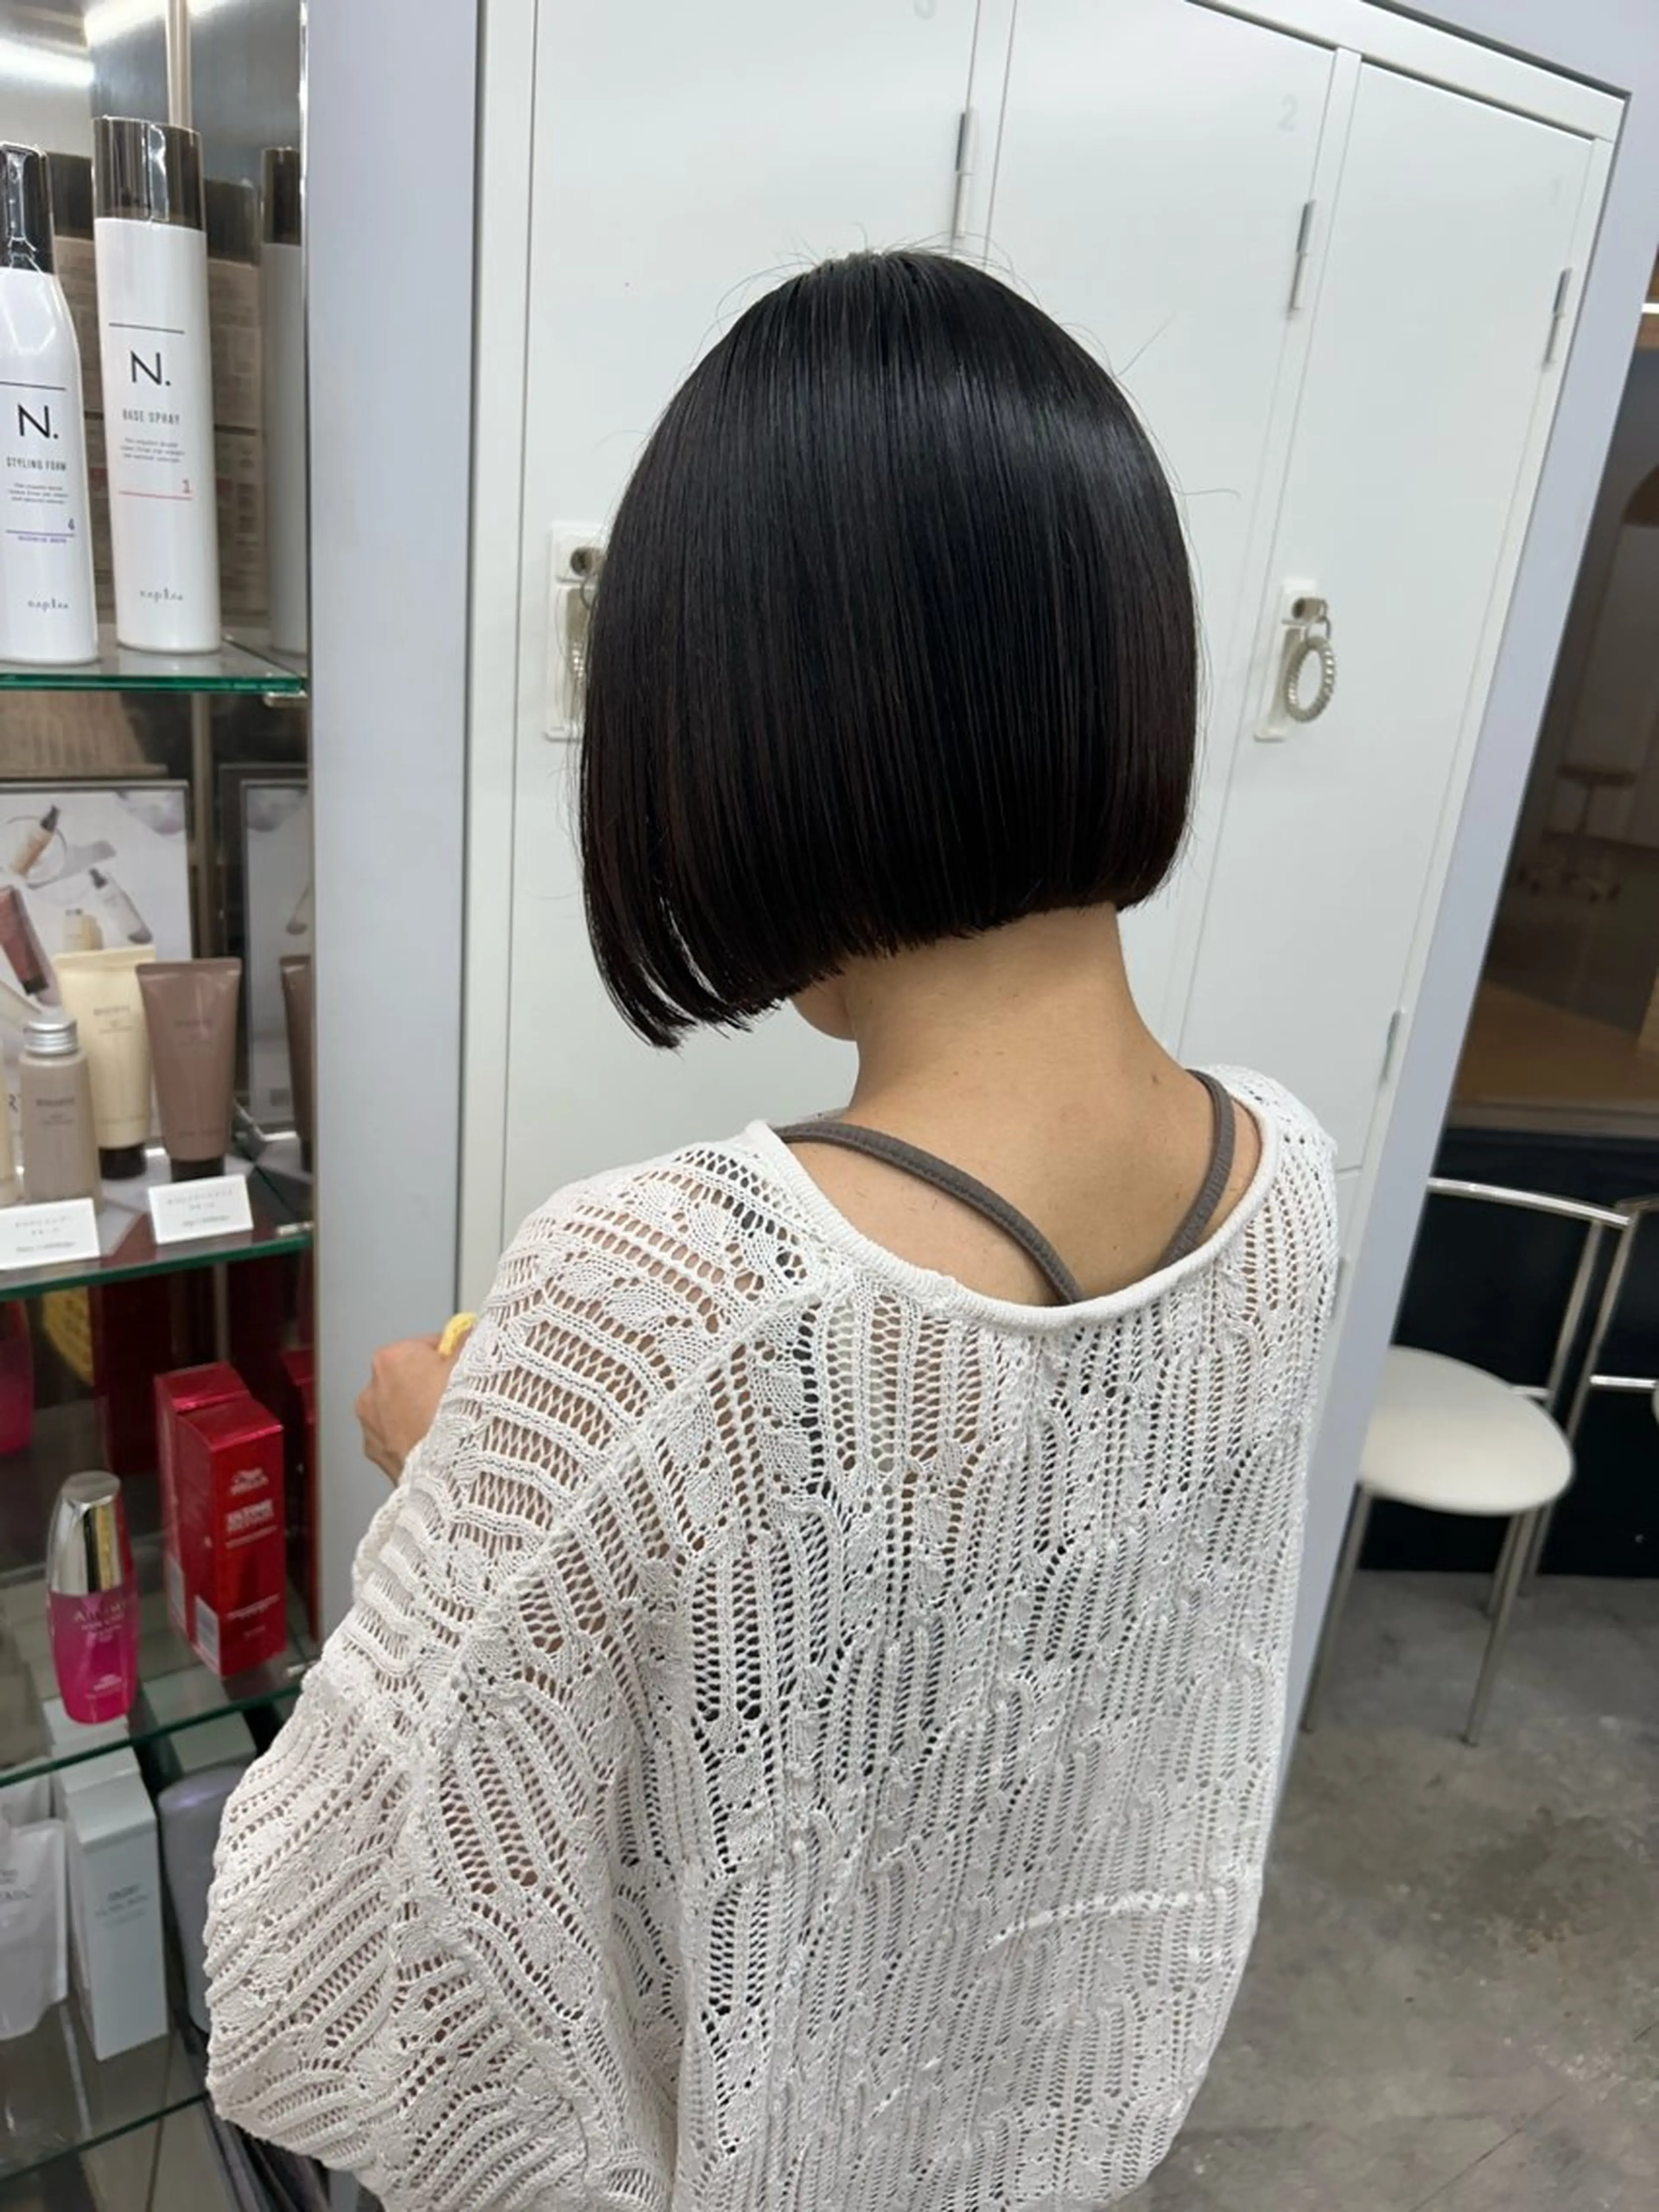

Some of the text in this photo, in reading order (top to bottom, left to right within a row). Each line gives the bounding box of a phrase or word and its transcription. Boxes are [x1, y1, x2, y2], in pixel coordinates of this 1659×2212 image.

[1276, 93, 1299, 133] 2
[130, 350, 171, 386] N.
[17, 404, 59, 439] N.
[122, 408, 180, 425] BASE SPRAY
